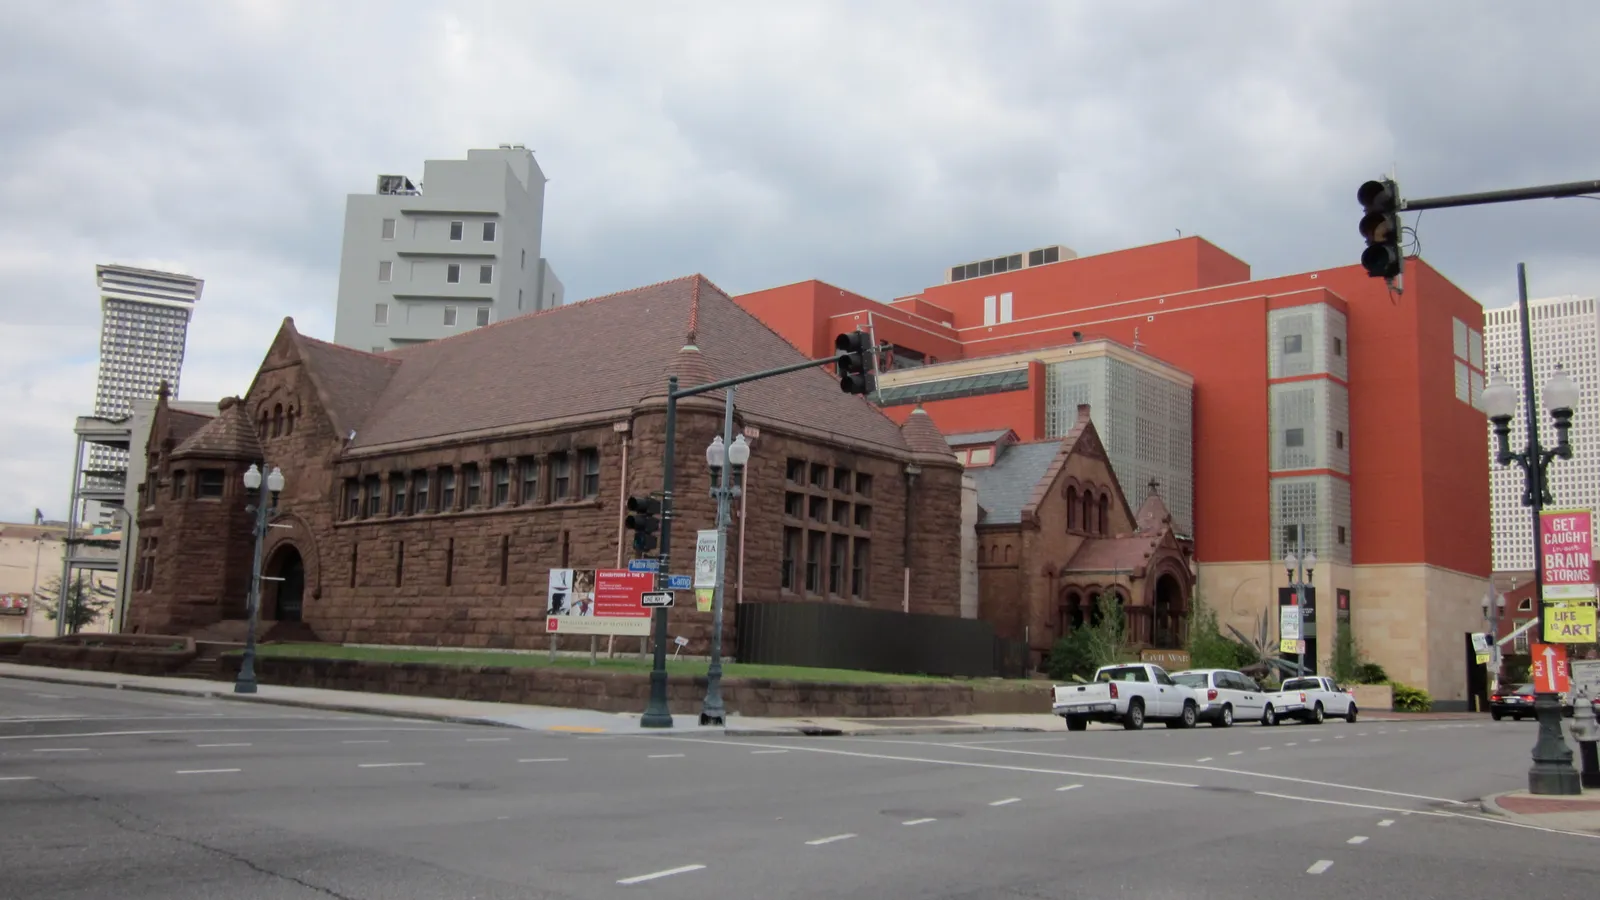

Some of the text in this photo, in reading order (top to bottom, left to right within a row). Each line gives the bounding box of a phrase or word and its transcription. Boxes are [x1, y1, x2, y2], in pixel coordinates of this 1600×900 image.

[1553, 517, 1576, 531] GET
[1544, 531, 1588, 545] CAUGHT
[1544, 552, 1589, 569] BRAIN
[1546, 569, 1590, 582] STORMS
[672, 577, 690, 588] Camp
[1554, 611, 1576, 622] LIFE
[1561, 624, 1592, 635] ART
[1141, 653, 1189, 662] CIVIL WAR
[1557, 660, 1566, 676] PLK
